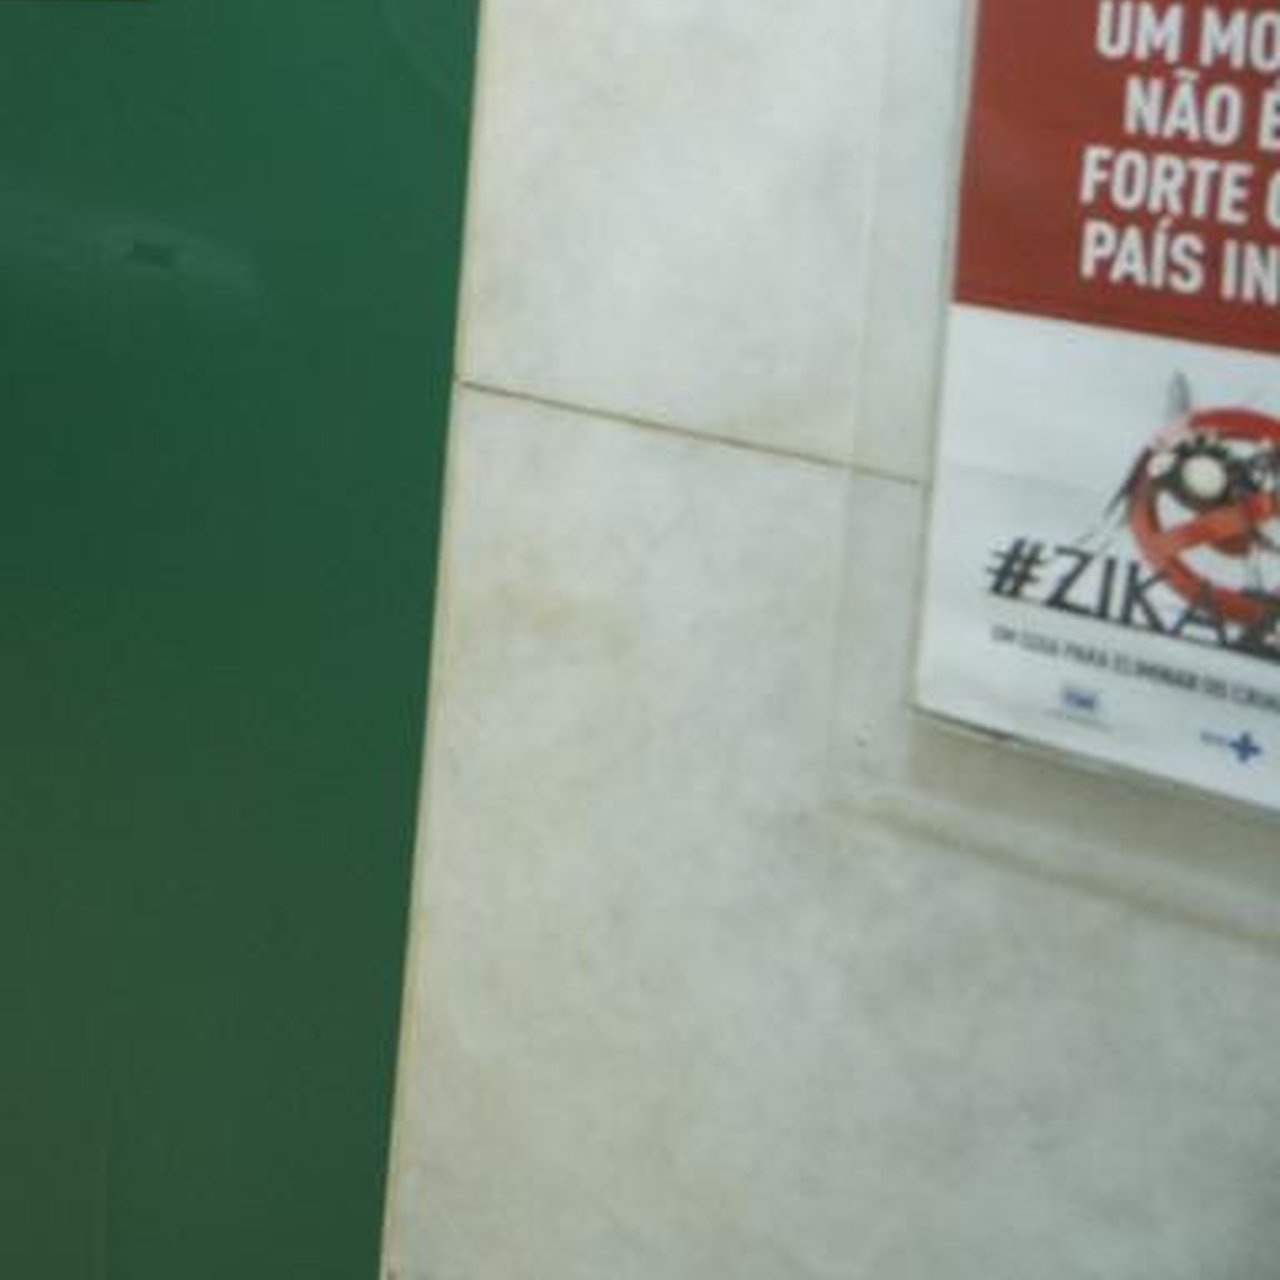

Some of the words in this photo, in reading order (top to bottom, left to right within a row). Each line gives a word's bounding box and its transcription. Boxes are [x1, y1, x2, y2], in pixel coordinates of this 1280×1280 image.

[1124, 68, 1242, 146] NÃO
[1080, 145, 1254, 226] FORTE
[1080, 217, 1205, 294] PAÍS
[1220, 238, 1280, 306] IN
